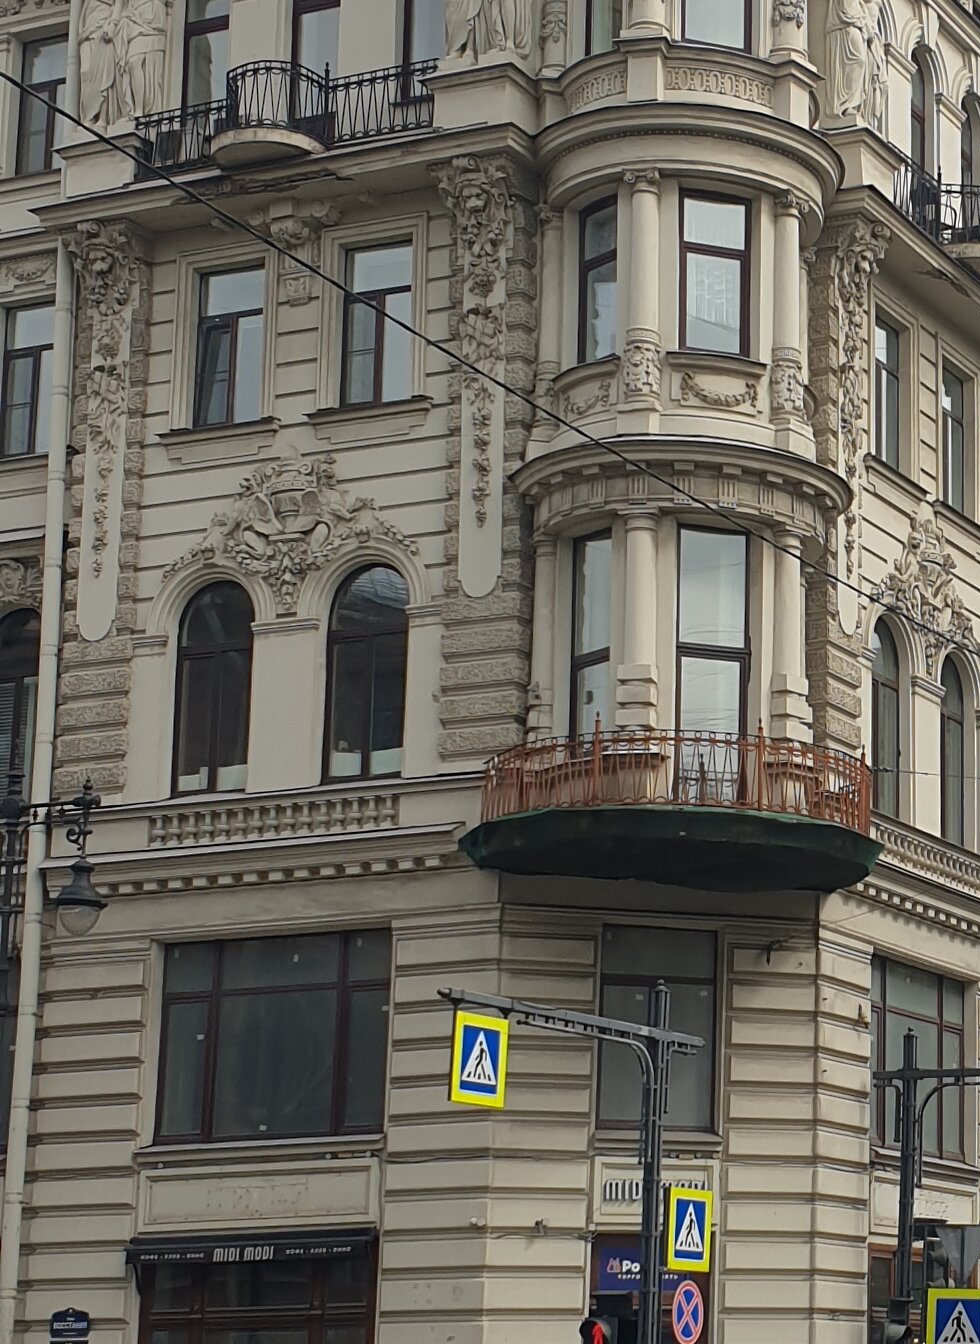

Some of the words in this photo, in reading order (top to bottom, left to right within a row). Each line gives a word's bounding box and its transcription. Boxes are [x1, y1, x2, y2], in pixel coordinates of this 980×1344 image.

[606, 1180, 643, 1200] MID
[213, 1248, 240, 1262] MIDI
[243, 1246, 274, 1261] MODI
